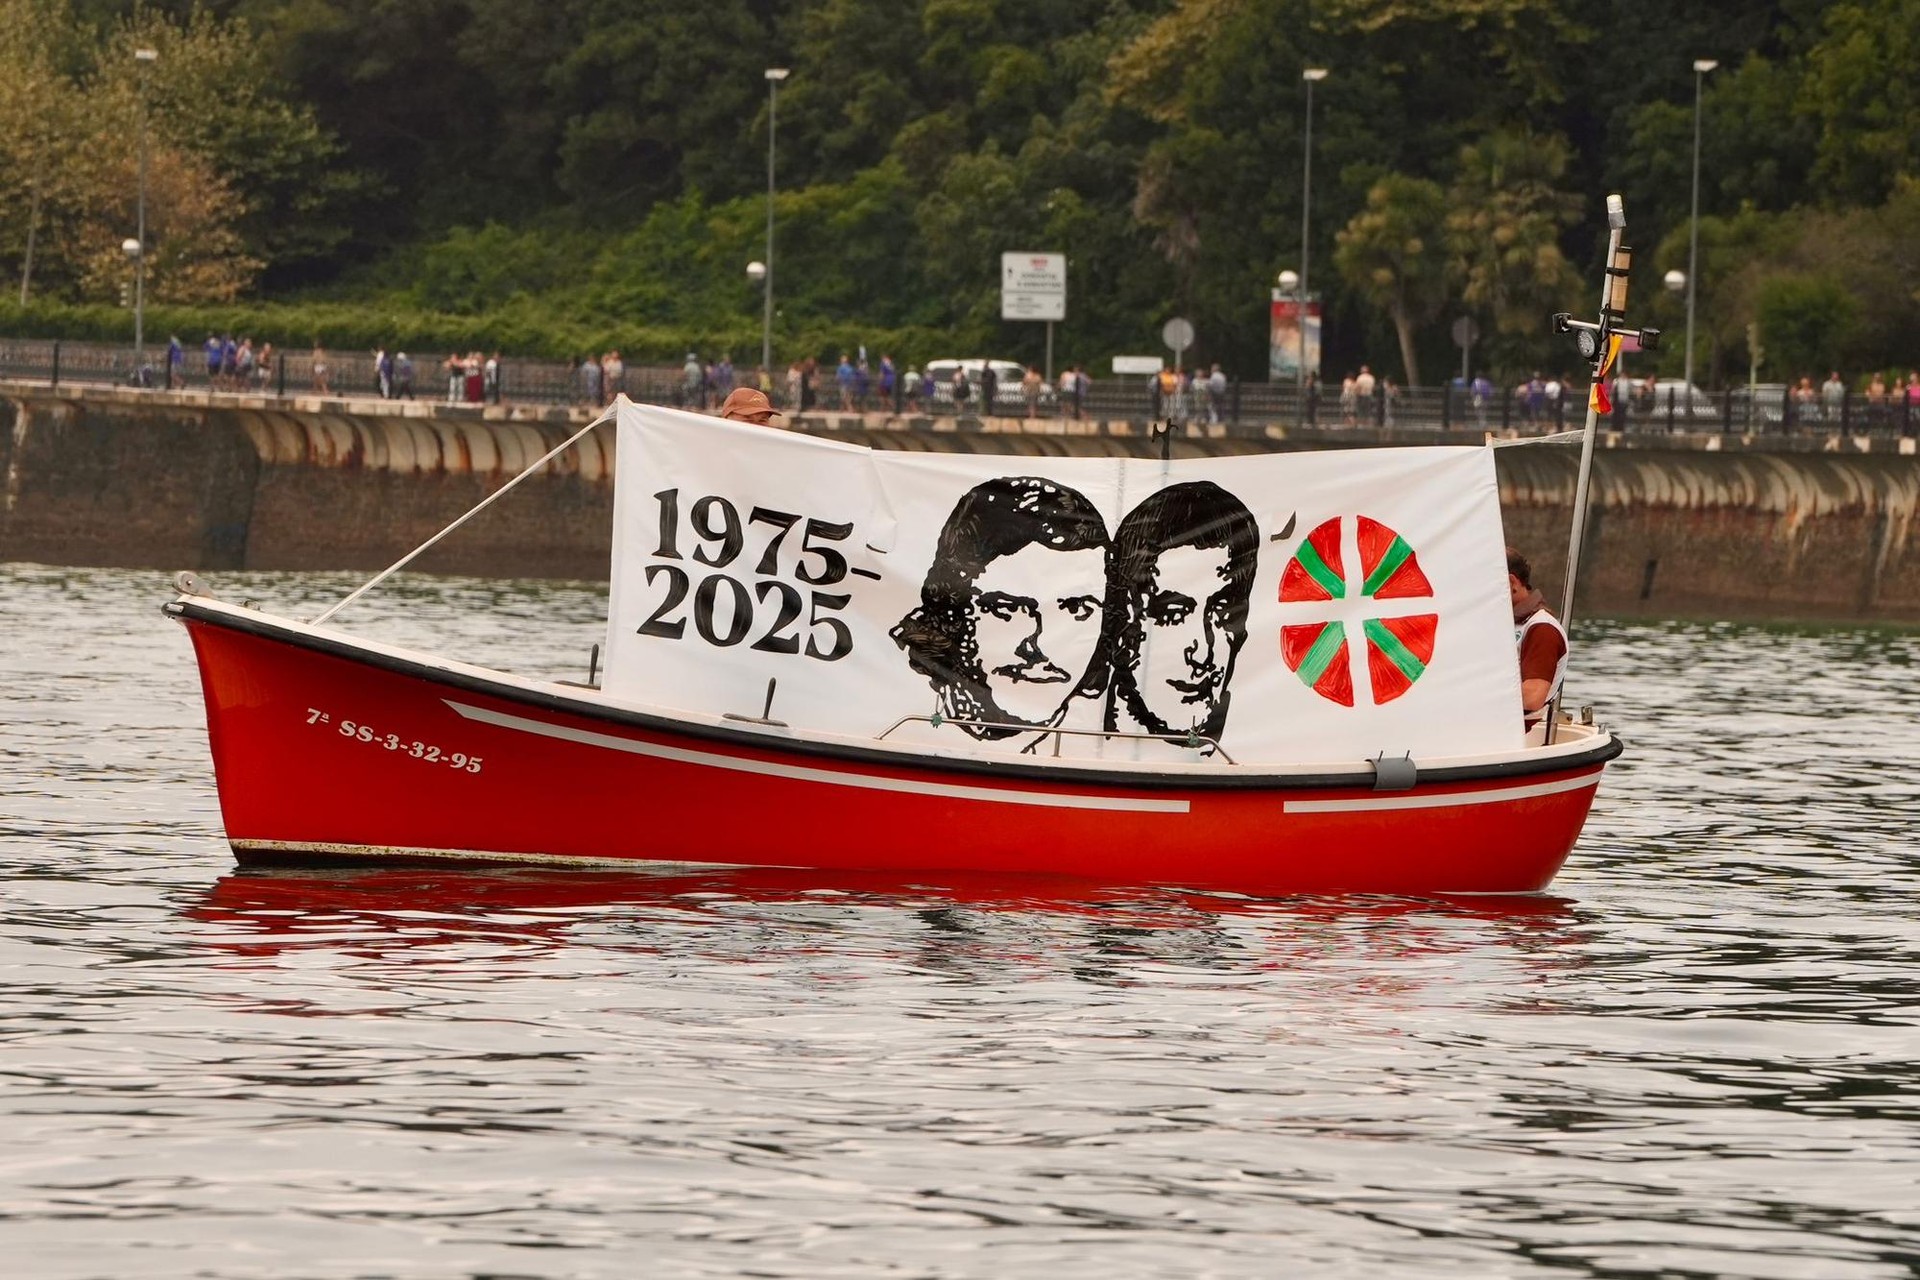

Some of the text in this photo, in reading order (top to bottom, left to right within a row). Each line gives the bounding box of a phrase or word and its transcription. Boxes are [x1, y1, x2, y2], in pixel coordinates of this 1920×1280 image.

[651, 488, 882, 586] 1975-
[636, 564, 854, 662] 2025
[338, 720, 483, 773] SS-3-32-95
